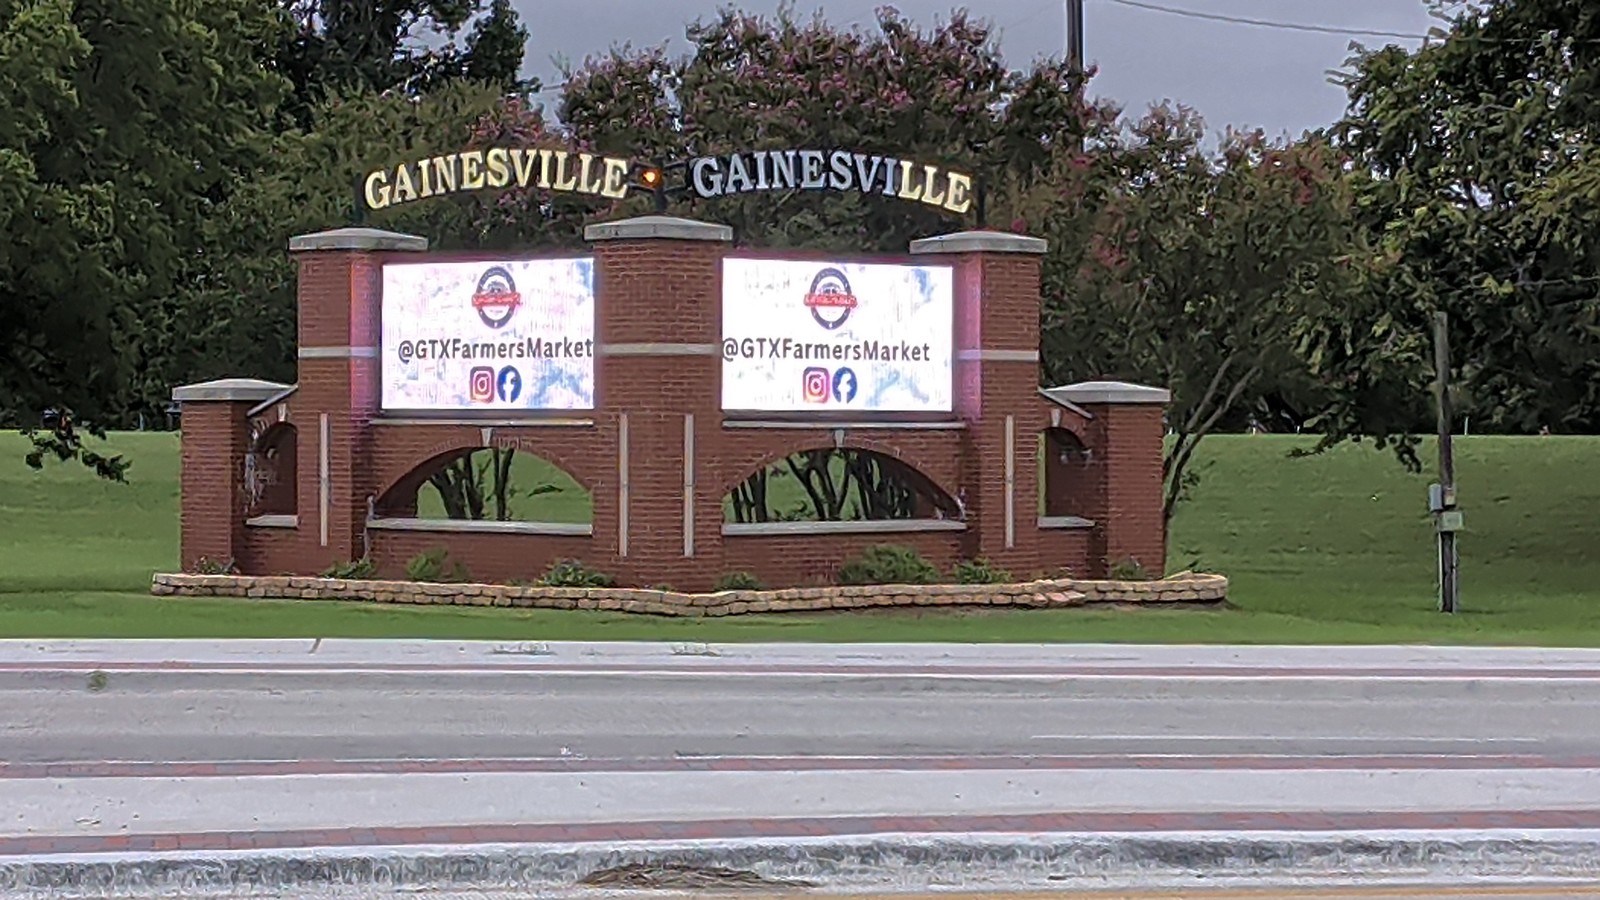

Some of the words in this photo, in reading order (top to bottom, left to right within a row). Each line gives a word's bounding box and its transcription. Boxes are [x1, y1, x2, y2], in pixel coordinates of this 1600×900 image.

[365, 148, 628, 209] GAINESVILLE
[692, 150, 972, 213] GAINESVILLE
[398, 336, 594, 364] @GTXFarmersMarket
[722, 337, 930, 362] @GTXFarmersMarket
